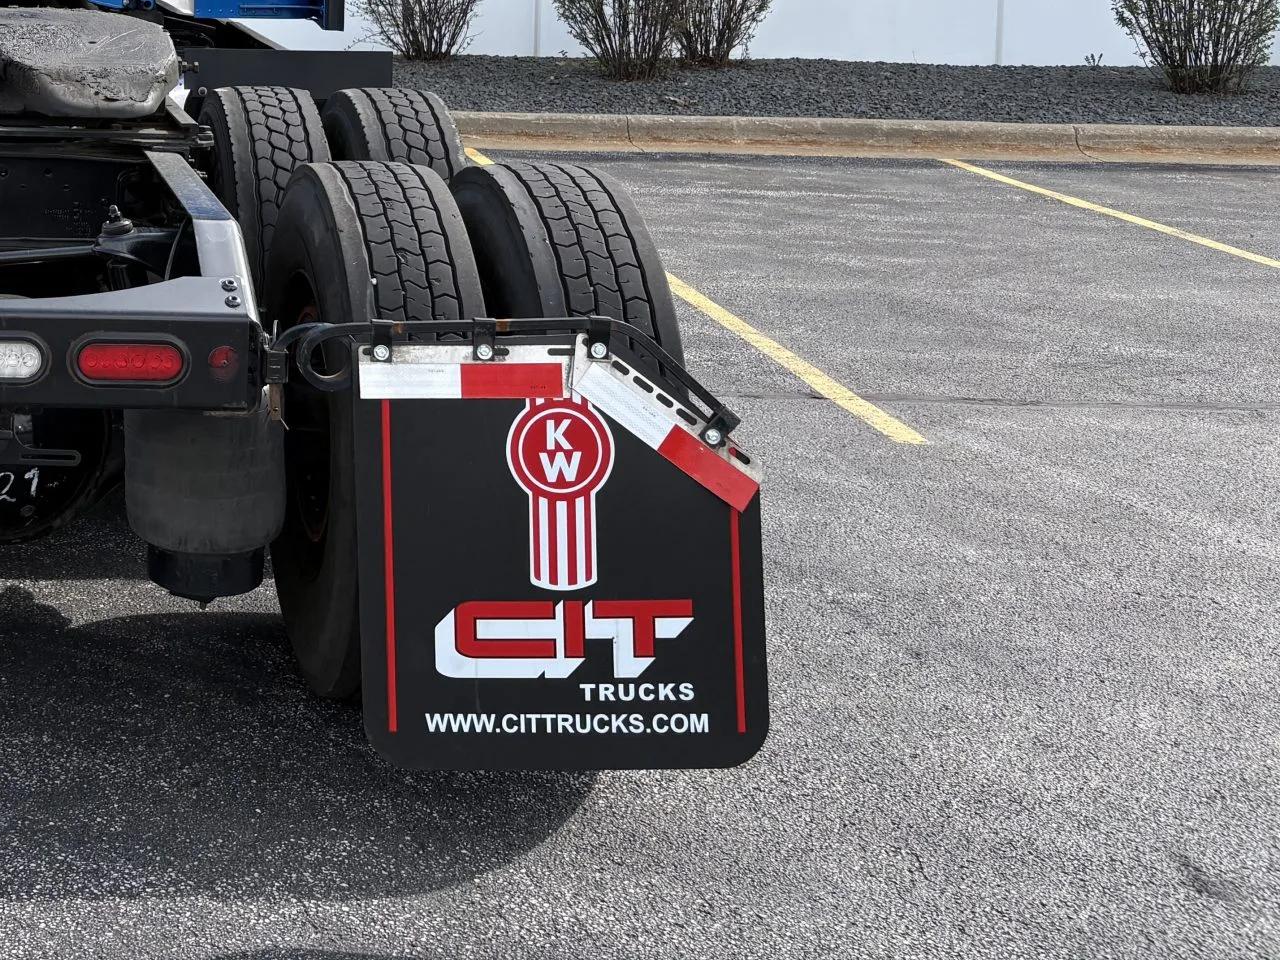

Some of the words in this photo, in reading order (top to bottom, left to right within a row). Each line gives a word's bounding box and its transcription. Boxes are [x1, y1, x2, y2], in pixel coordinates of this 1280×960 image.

[546, 419, 573, 450] K
[539, 451, 581, 482] W
[435, 599, 694, 678] CIT
[579, 683, 695, 702] TRUCKS
[425, 712, 710, 734] WWW.CITTRUCKS.COM
